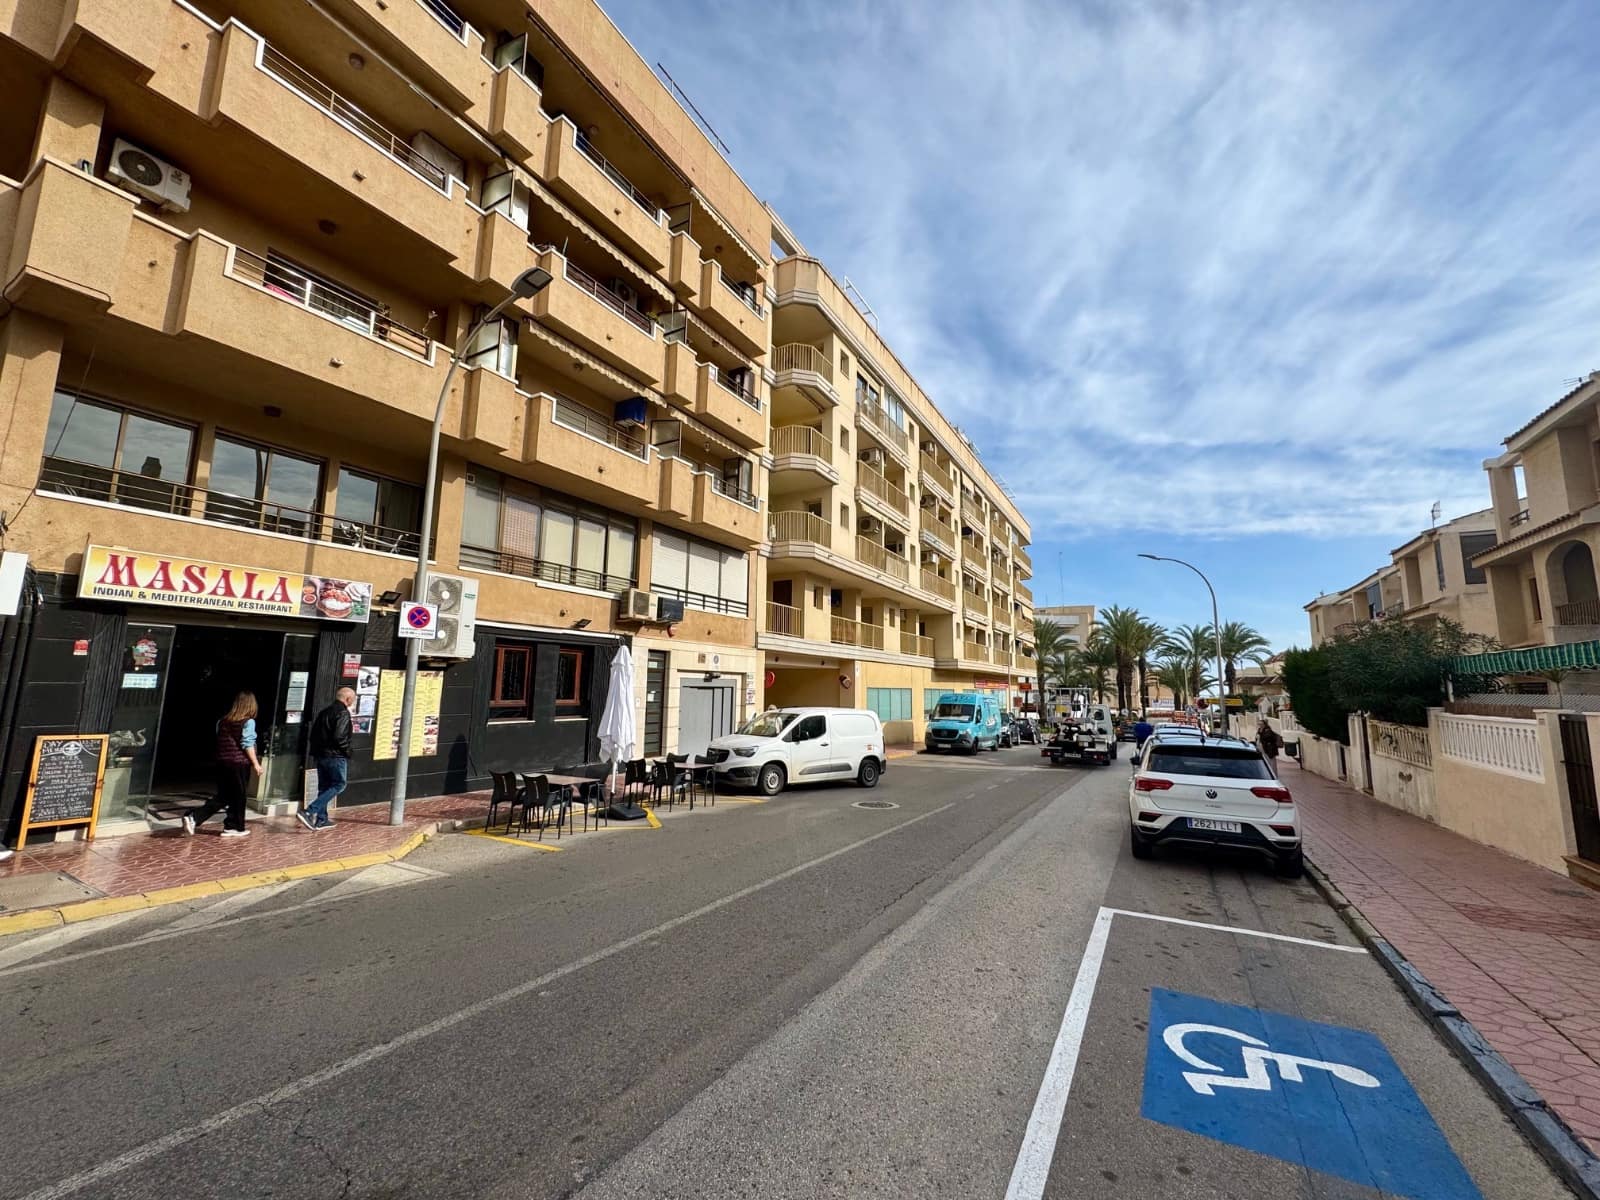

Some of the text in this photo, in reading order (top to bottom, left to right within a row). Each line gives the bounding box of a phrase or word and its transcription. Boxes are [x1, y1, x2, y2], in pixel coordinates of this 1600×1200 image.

[96, 554, 293, 604] MASALA
[93, 586, 293, 614] INDIAN & MEDITERRANEAN RESTAURANT
